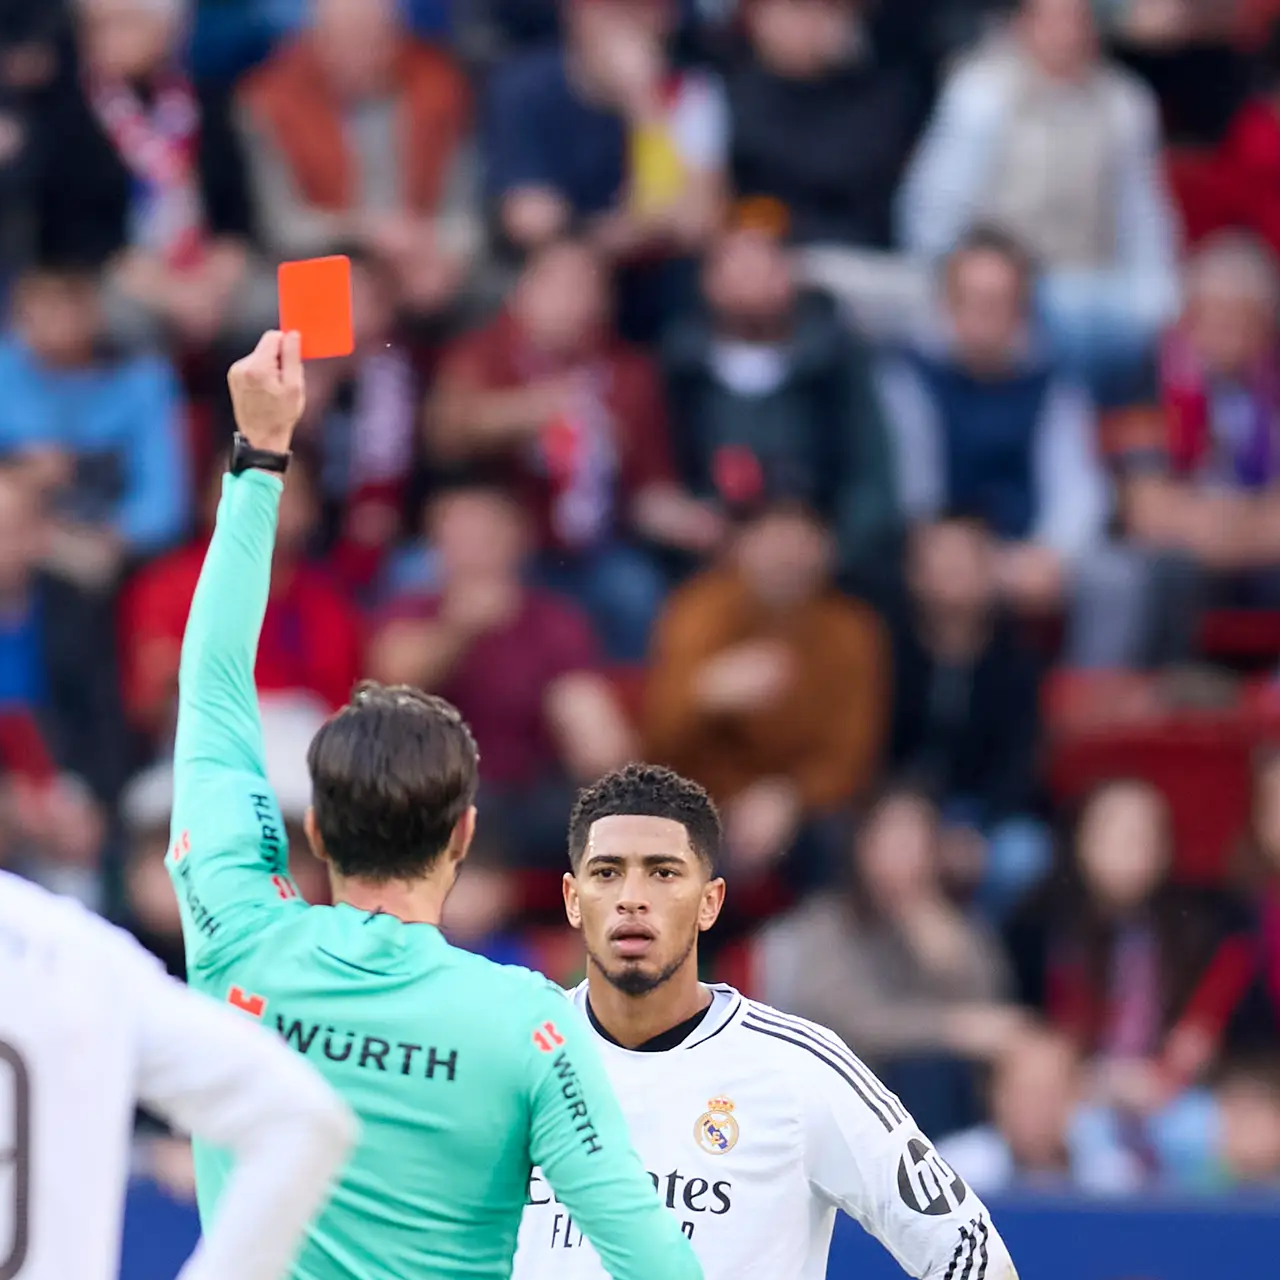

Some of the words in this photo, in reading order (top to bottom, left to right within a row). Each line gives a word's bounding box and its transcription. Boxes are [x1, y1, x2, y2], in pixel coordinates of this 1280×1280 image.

[276, 1013, 459, 1082] WÜRTH
[552, 1052, 604, 1156] WÜRTH
[900, 1138, 963, 1213] hp
